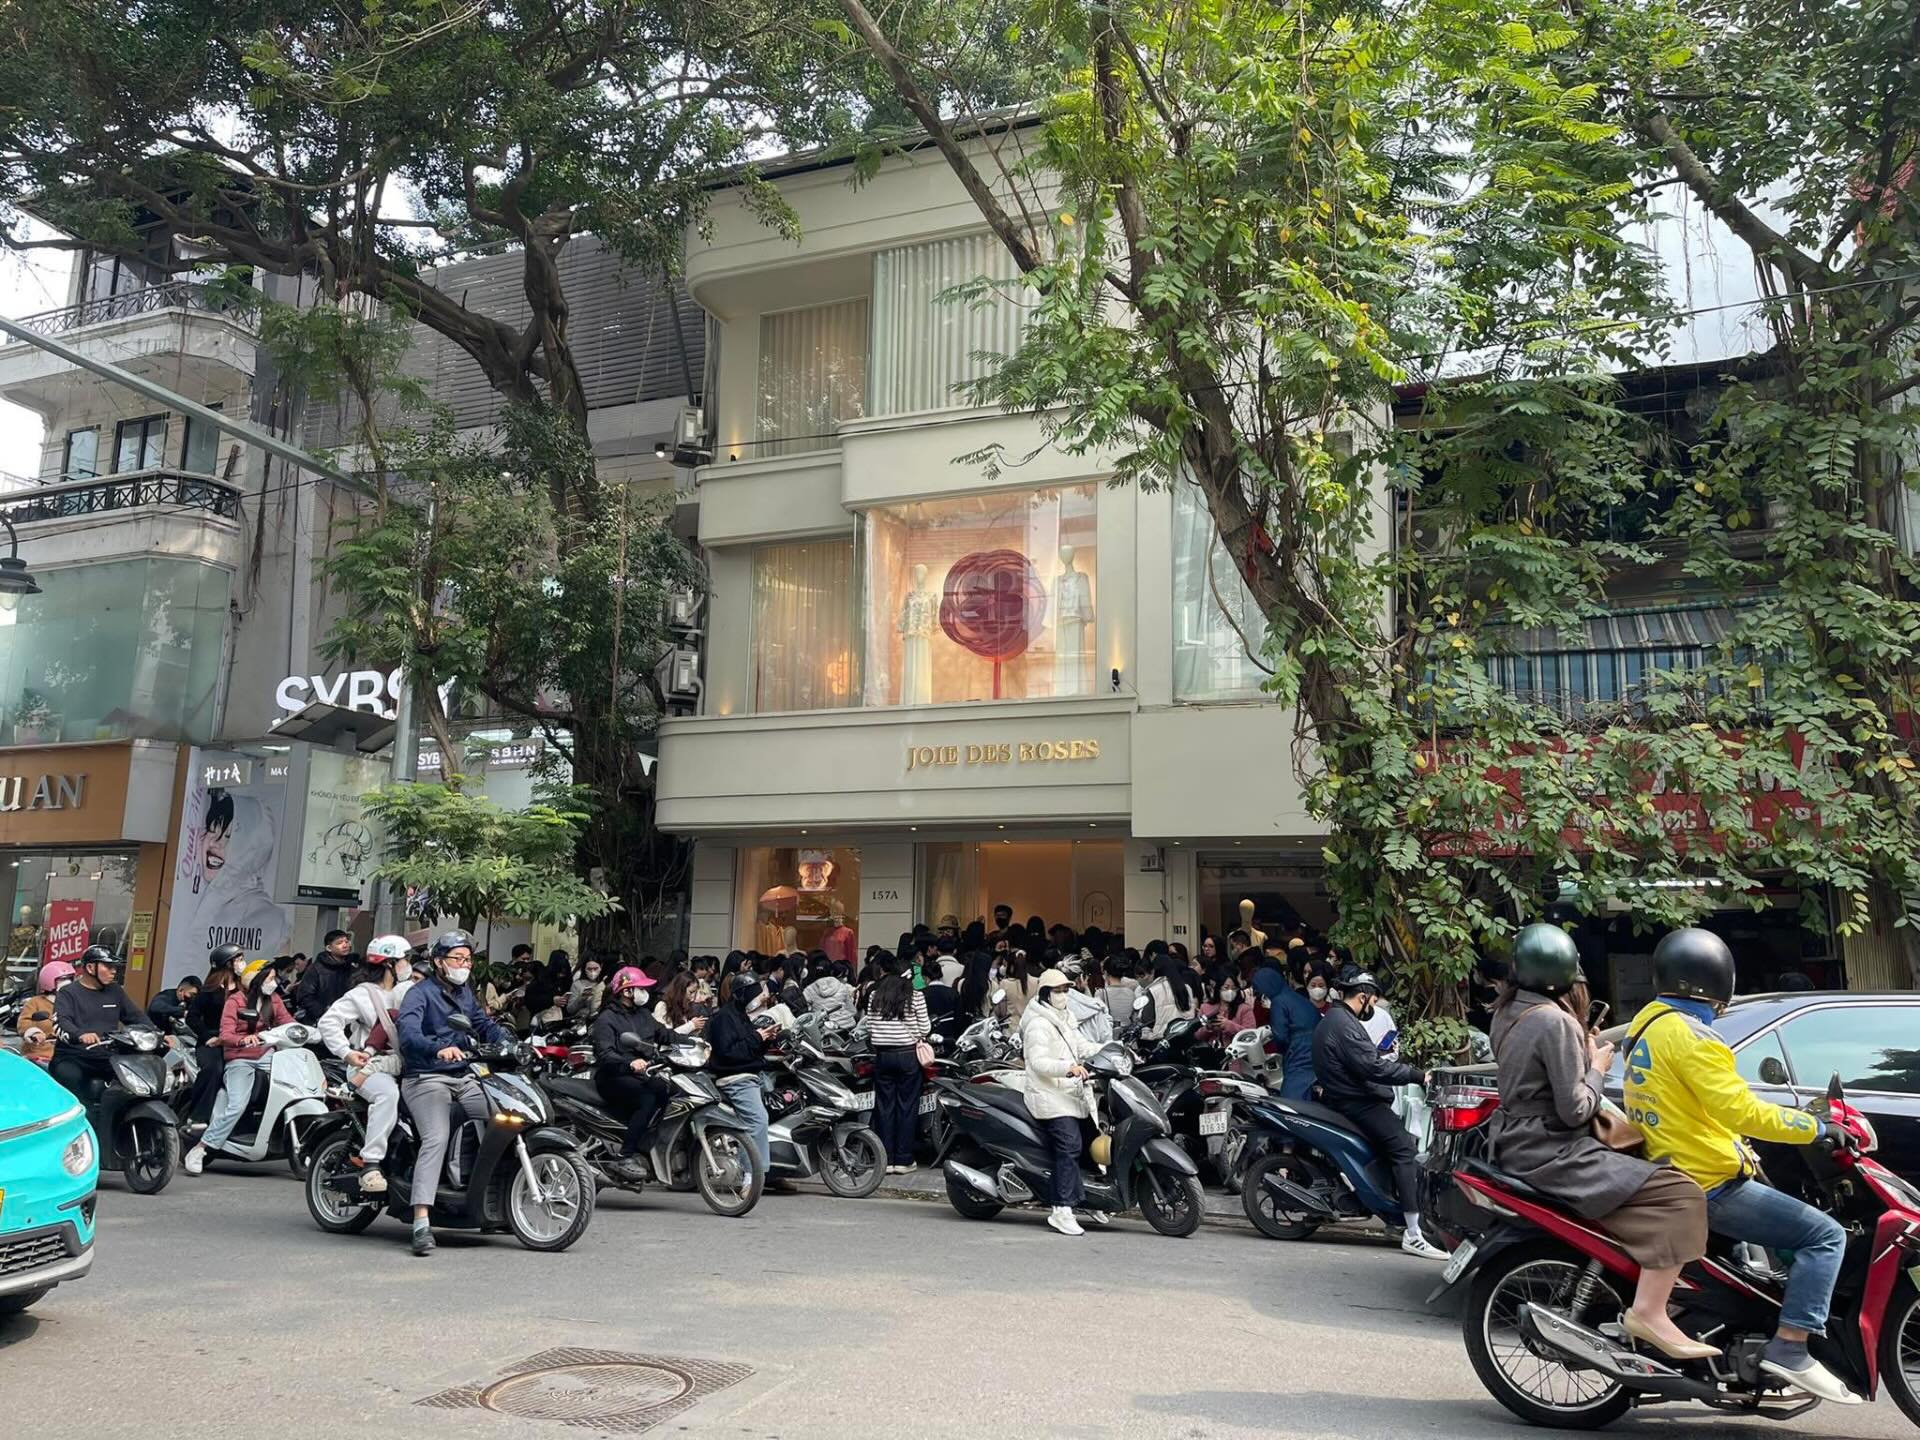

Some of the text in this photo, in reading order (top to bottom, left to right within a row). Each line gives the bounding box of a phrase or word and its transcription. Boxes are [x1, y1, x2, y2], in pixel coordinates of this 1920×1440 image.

[908, 740, 1100, 770] JOIE DES ROSES
[872, 890, 898, 900] 157A
[50, 917, 88, 942] MEGA
[207, 925, 262, 951] SOYOUNG
[51, 936, 82, 959] SALE
